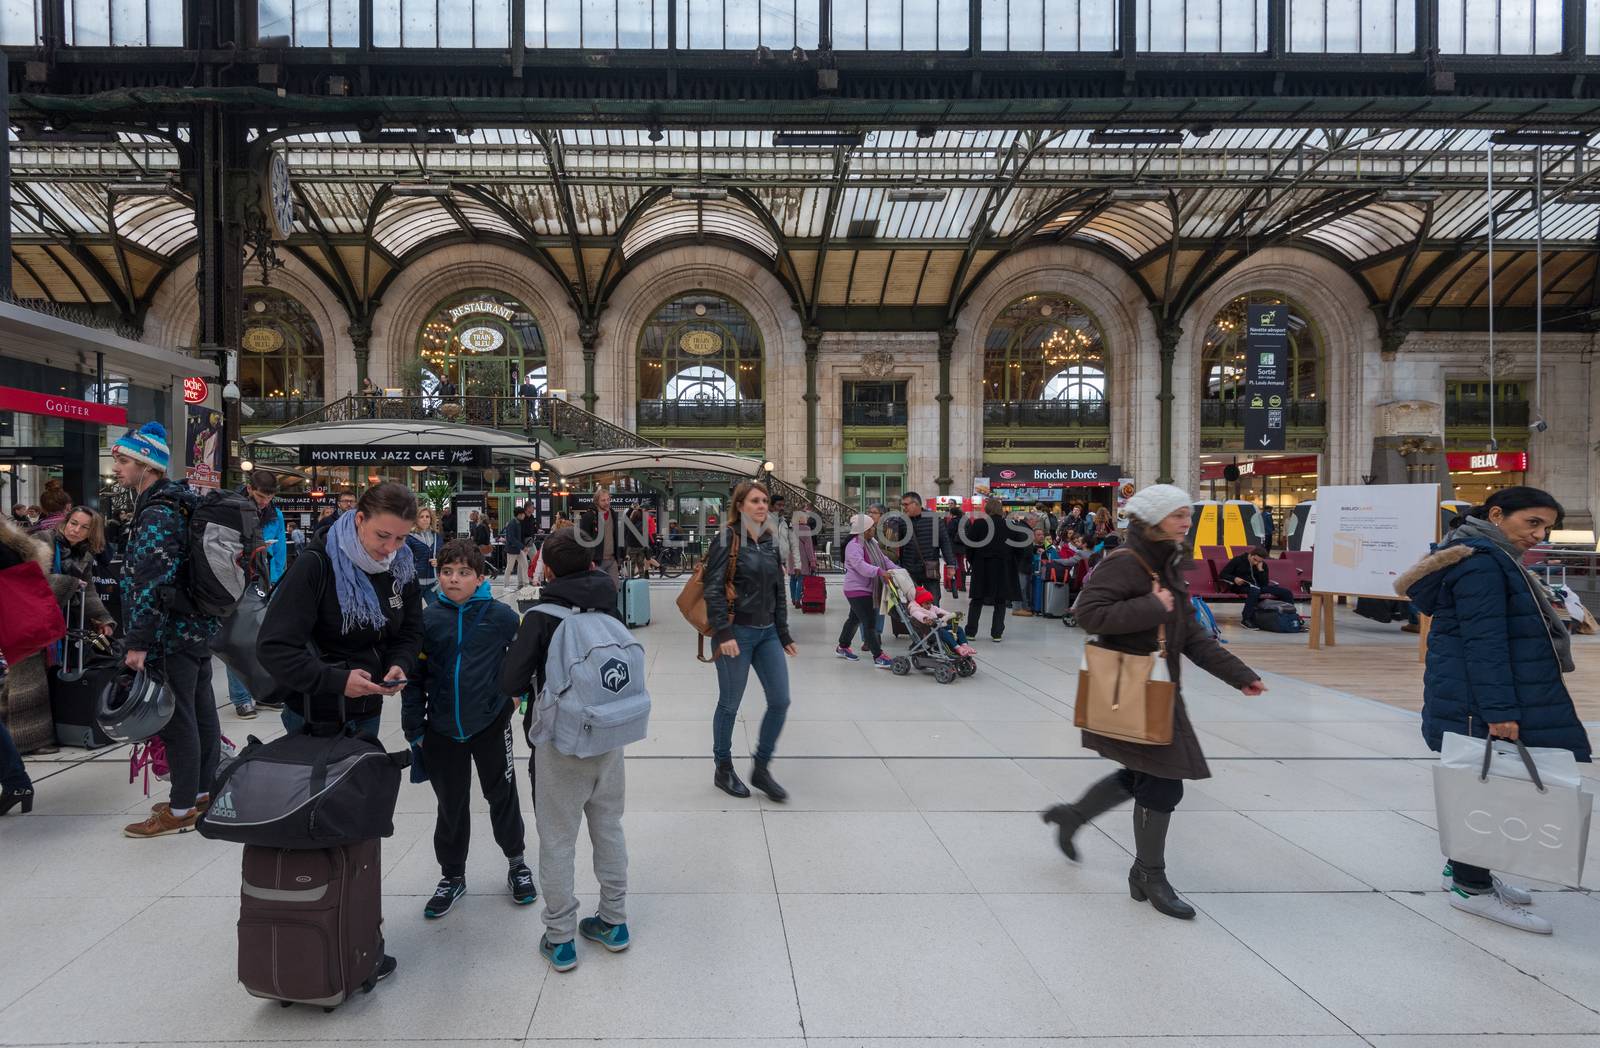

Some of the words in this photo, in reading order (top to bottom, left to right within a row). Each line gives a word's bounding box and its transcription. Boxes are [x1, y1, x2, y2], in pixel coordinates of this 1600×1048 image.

[451, 302, 513, 321] RESTAURANT
[184, 378, 201, 391] oche
[312, 451, 377, 460] MONTREUX
[381, 451, 411, 460] JAZZ
[415, 449, 445, 460] CAFÉ
[1034, 469, 1068, 480] Brioche
[1071, 469, 1098, 480] Dorée
[1464, 810, 1563, 849] COS
